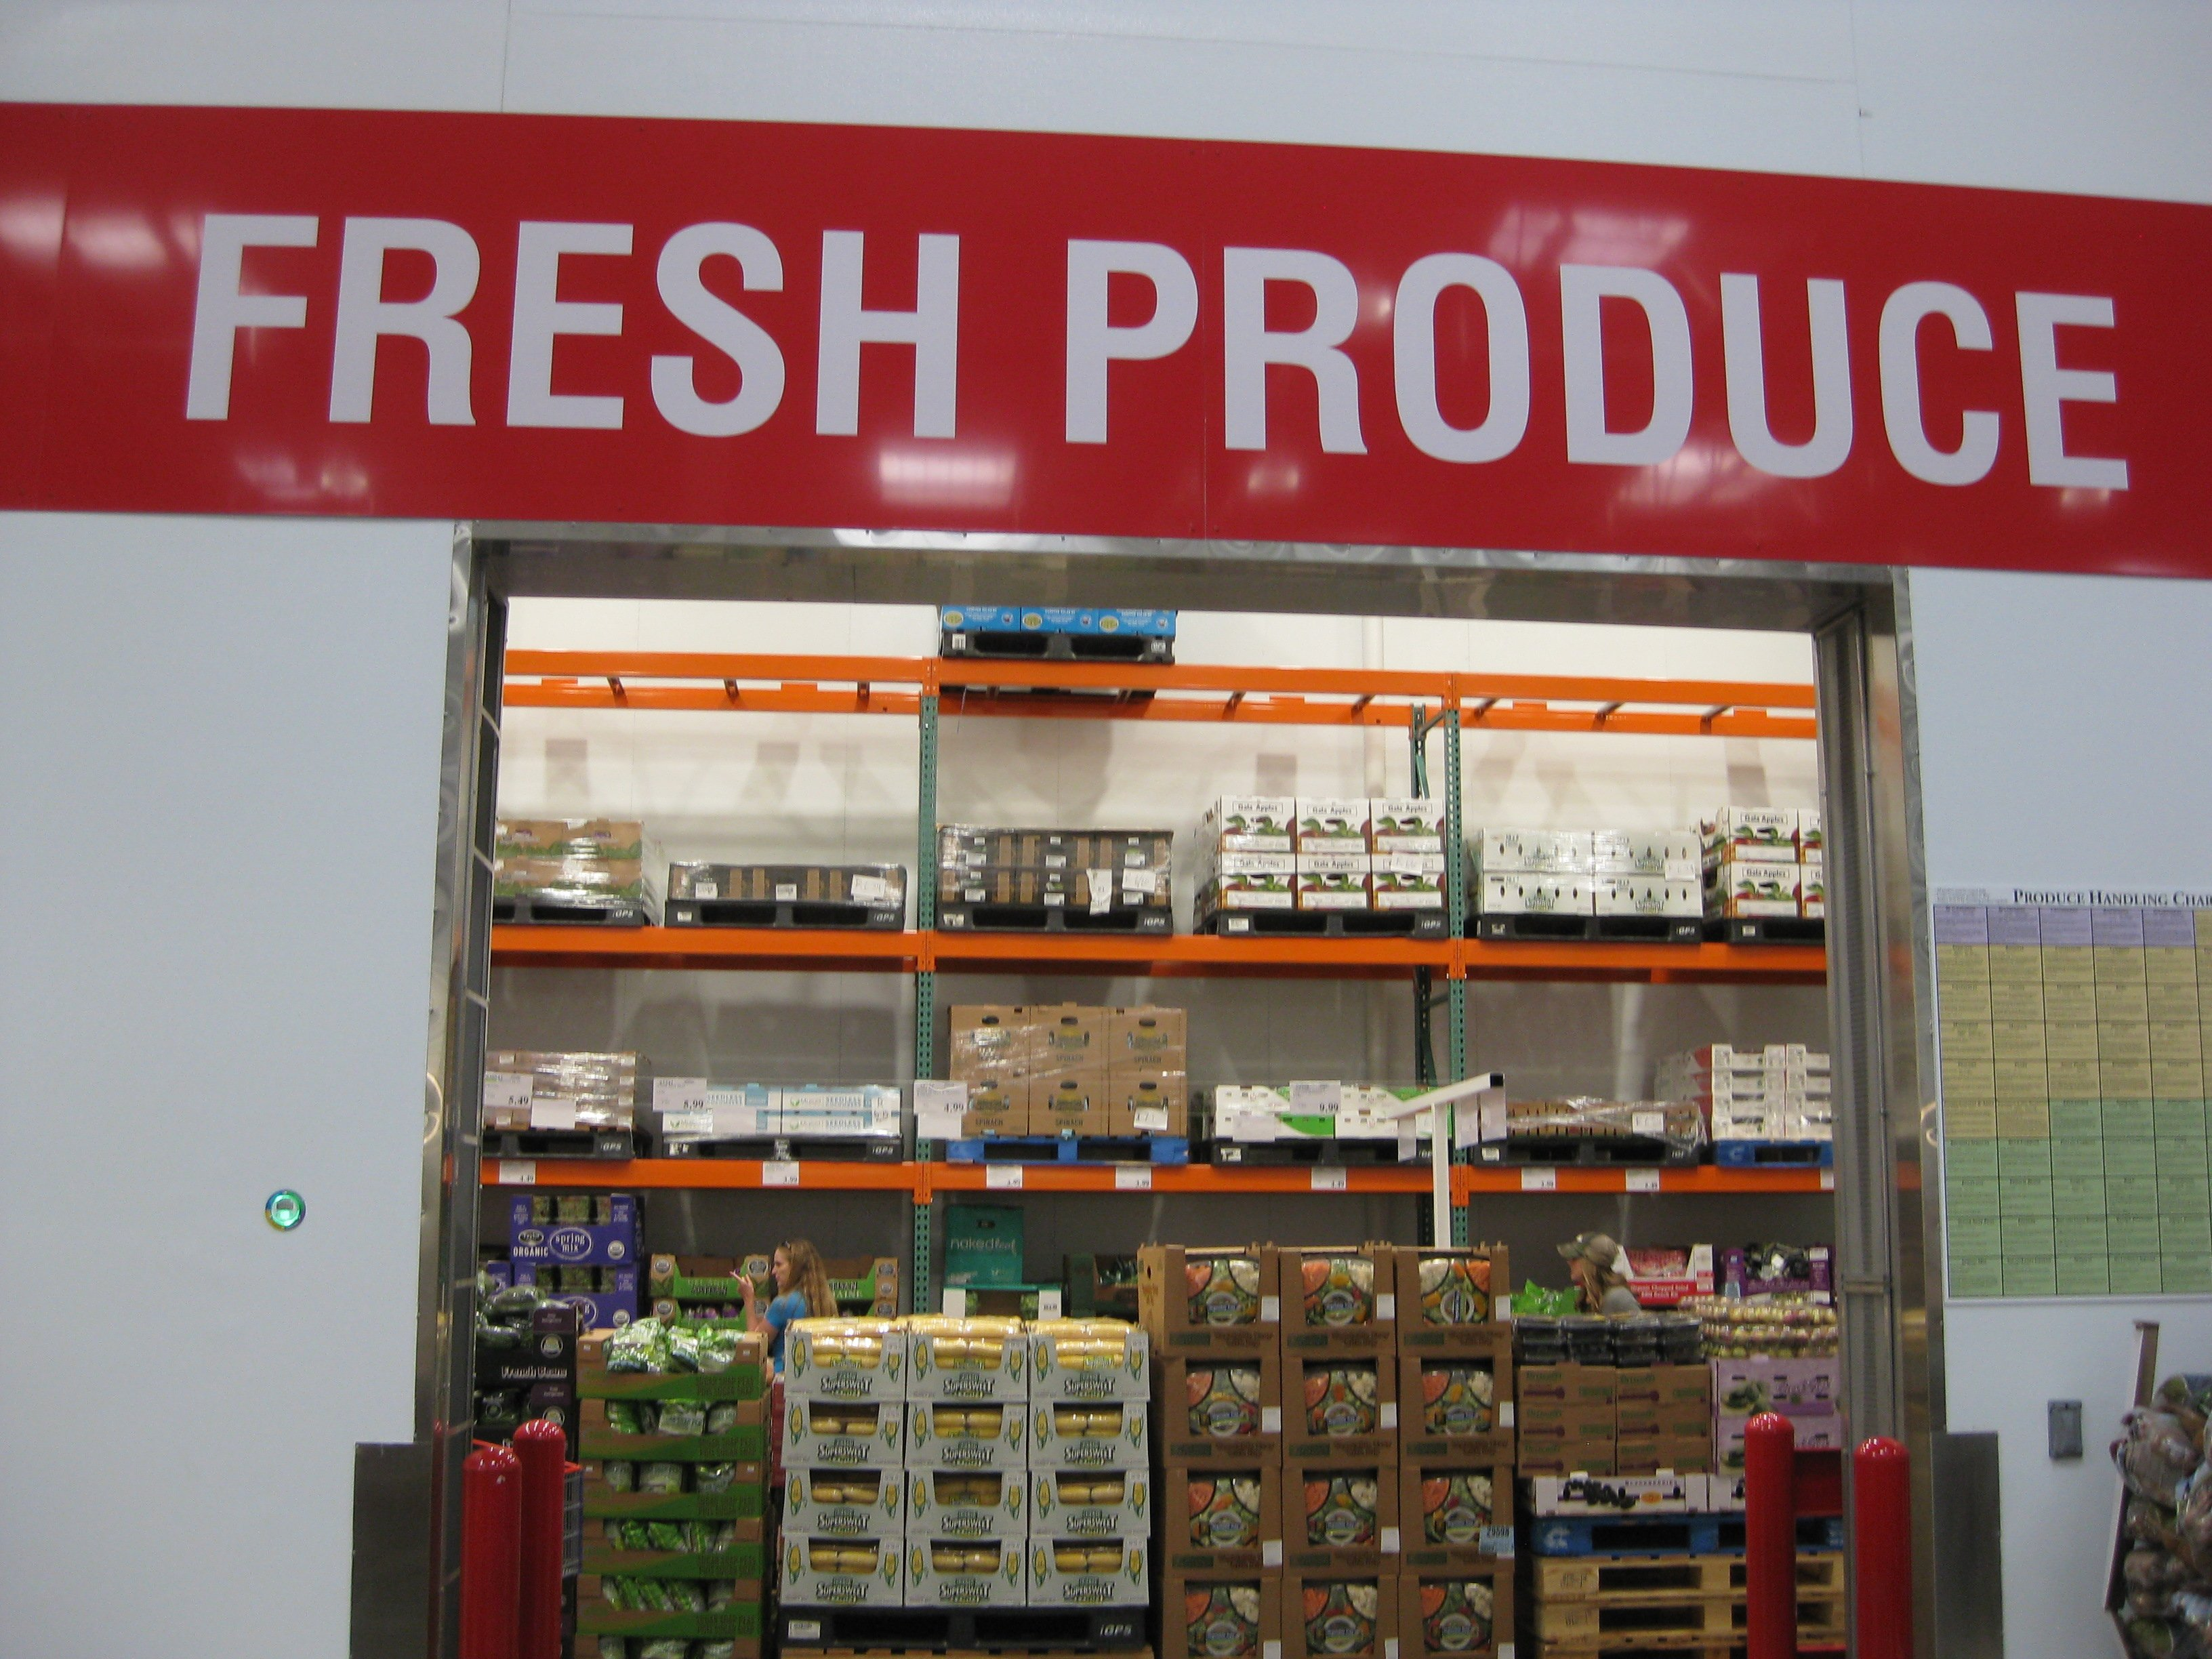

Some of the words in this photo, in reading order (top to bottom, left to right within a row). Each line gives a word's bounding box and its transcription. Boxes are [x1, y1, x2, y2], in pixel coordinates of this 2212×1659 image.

[186, 214, 960, 438] FRESH
[1065, 239, 2129, 492] PRODUCE
[555, 1233, 586, 1245] spring
[513, 1246, 549, 1258] ORGANIC
[562, 1244, 579, 1252] mix
